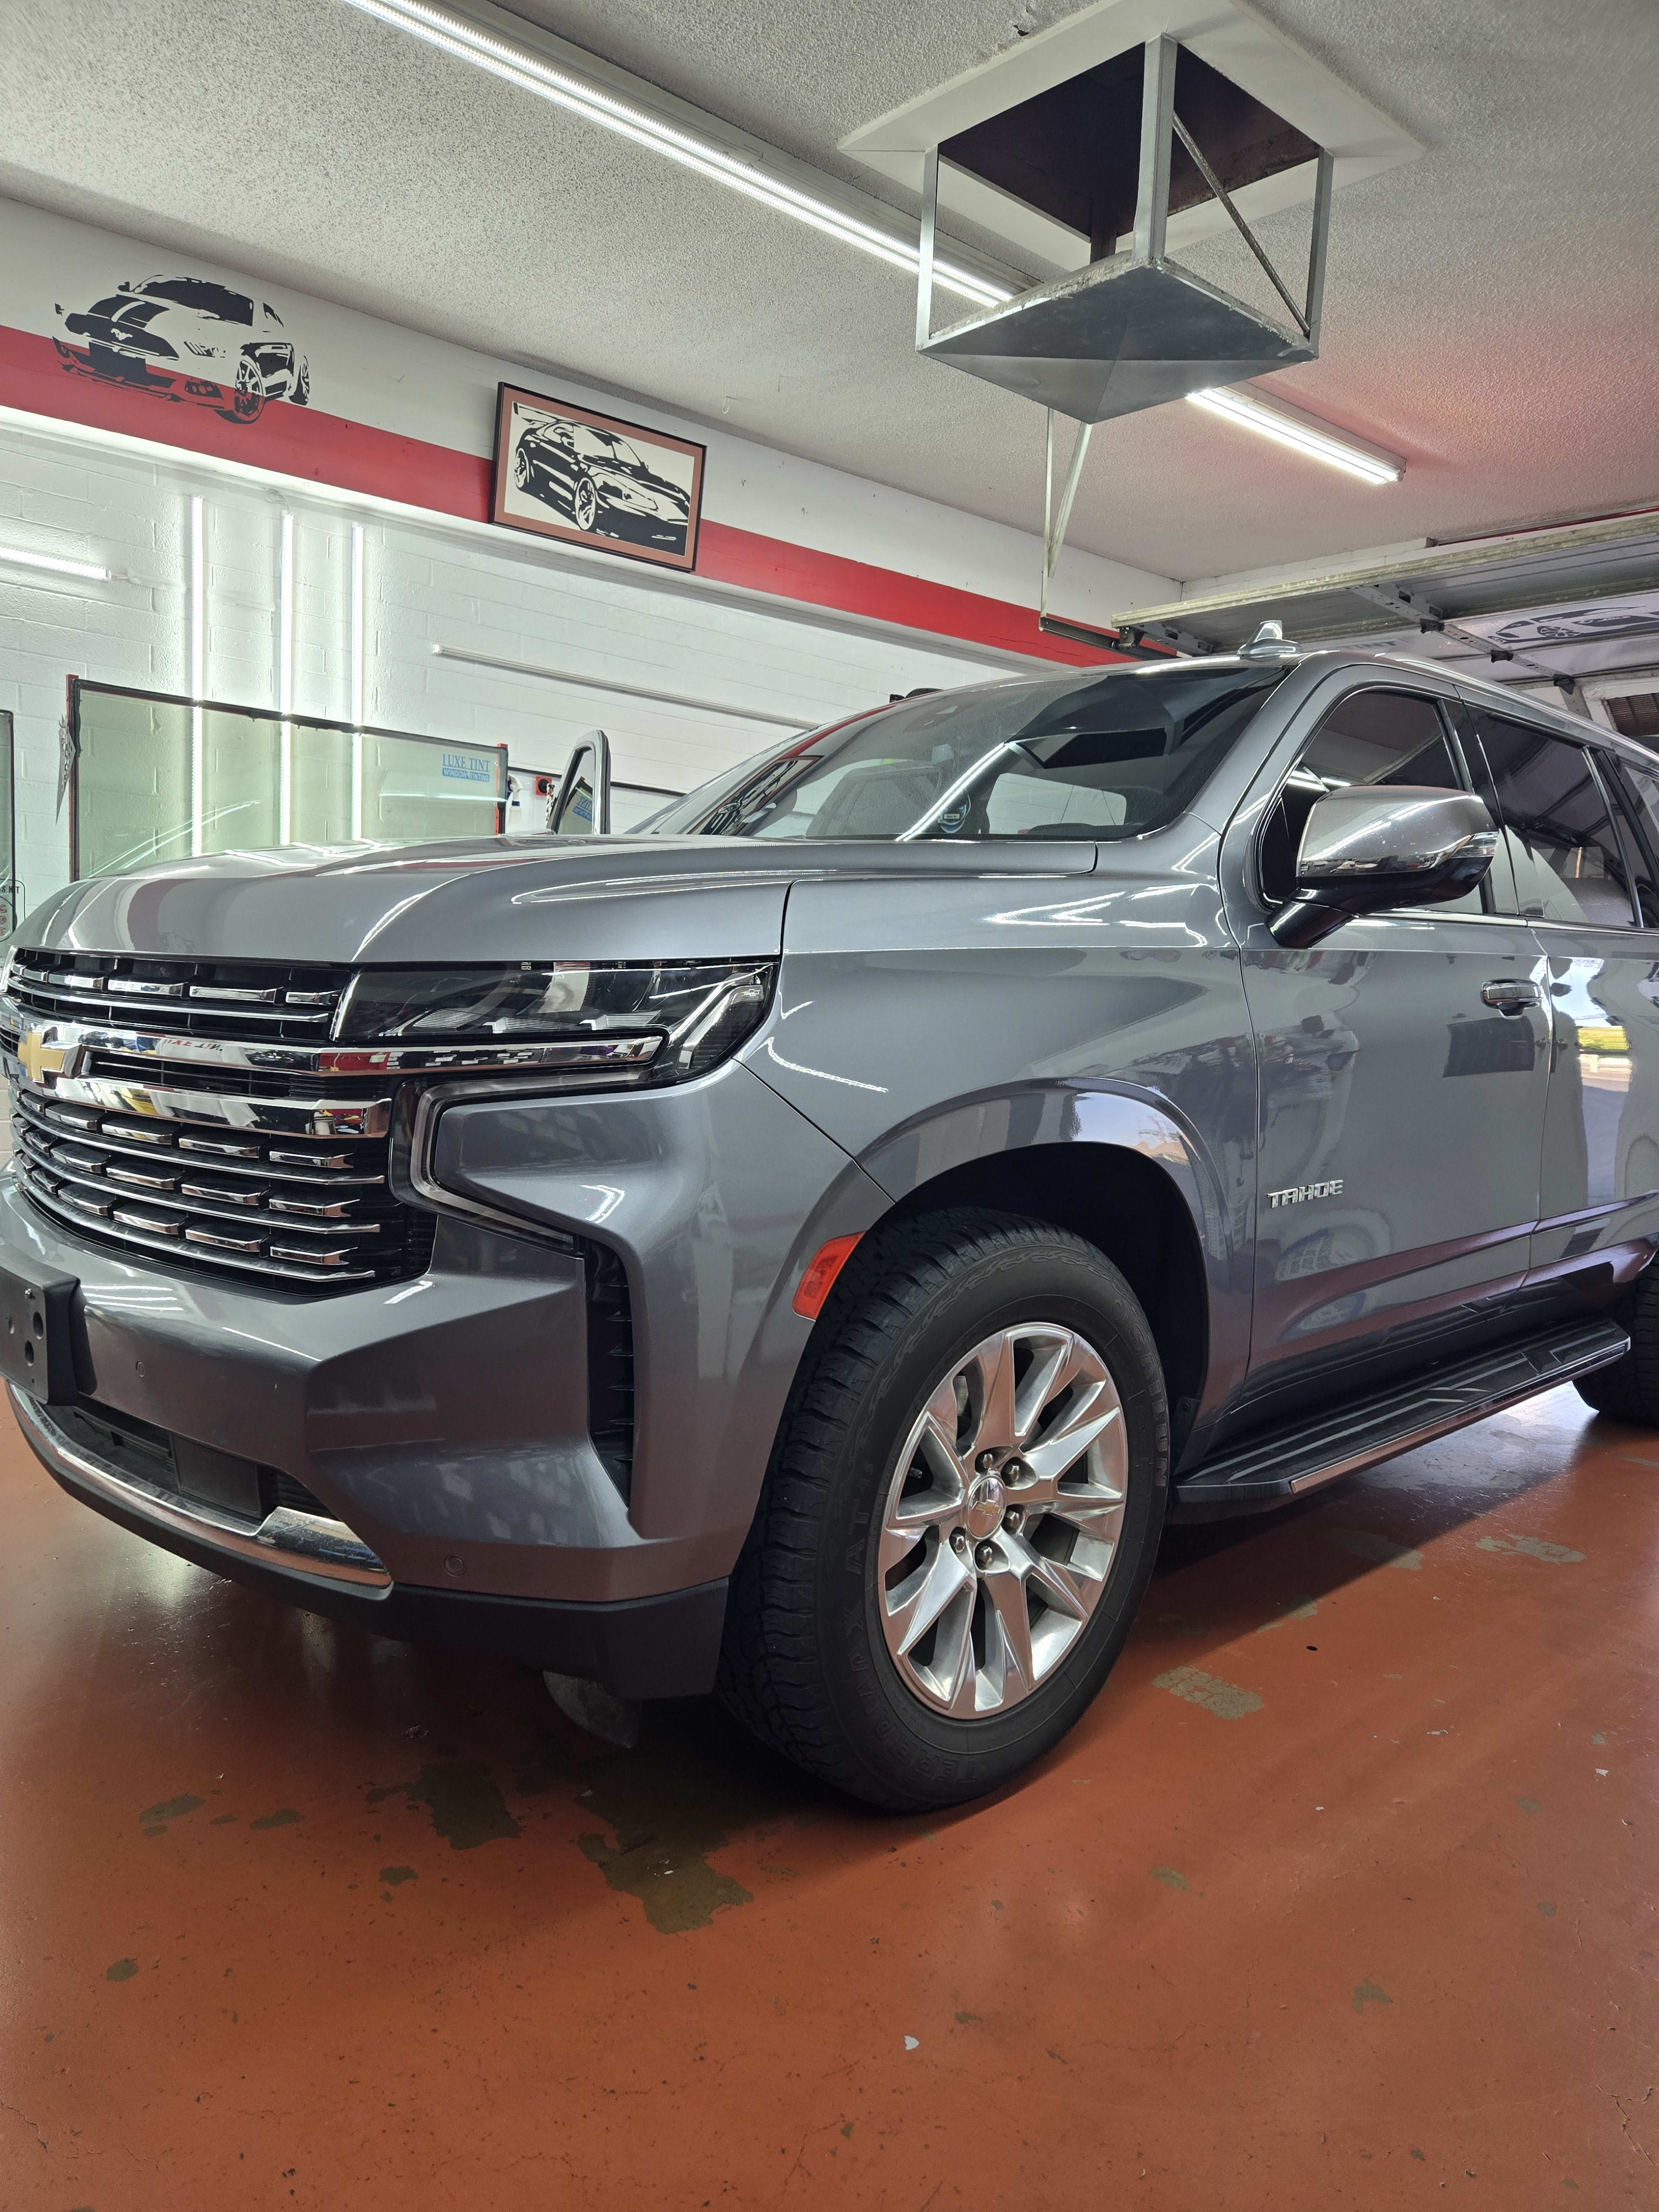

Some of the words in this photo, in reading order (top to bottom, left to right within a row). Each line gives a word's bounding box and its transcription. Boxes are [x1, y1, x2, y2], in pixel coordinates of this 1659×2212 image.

[442, 753, 466, 769] LUXE
[469, 757, 490, 772] TINT
[444, 768, 467, 779] WINDOW
[468, 772, 489, 781] TINTING
[1267, 1179, 1344, 1208] TAHOE
[1128, 1323, 1168, 1488] SAILUN
